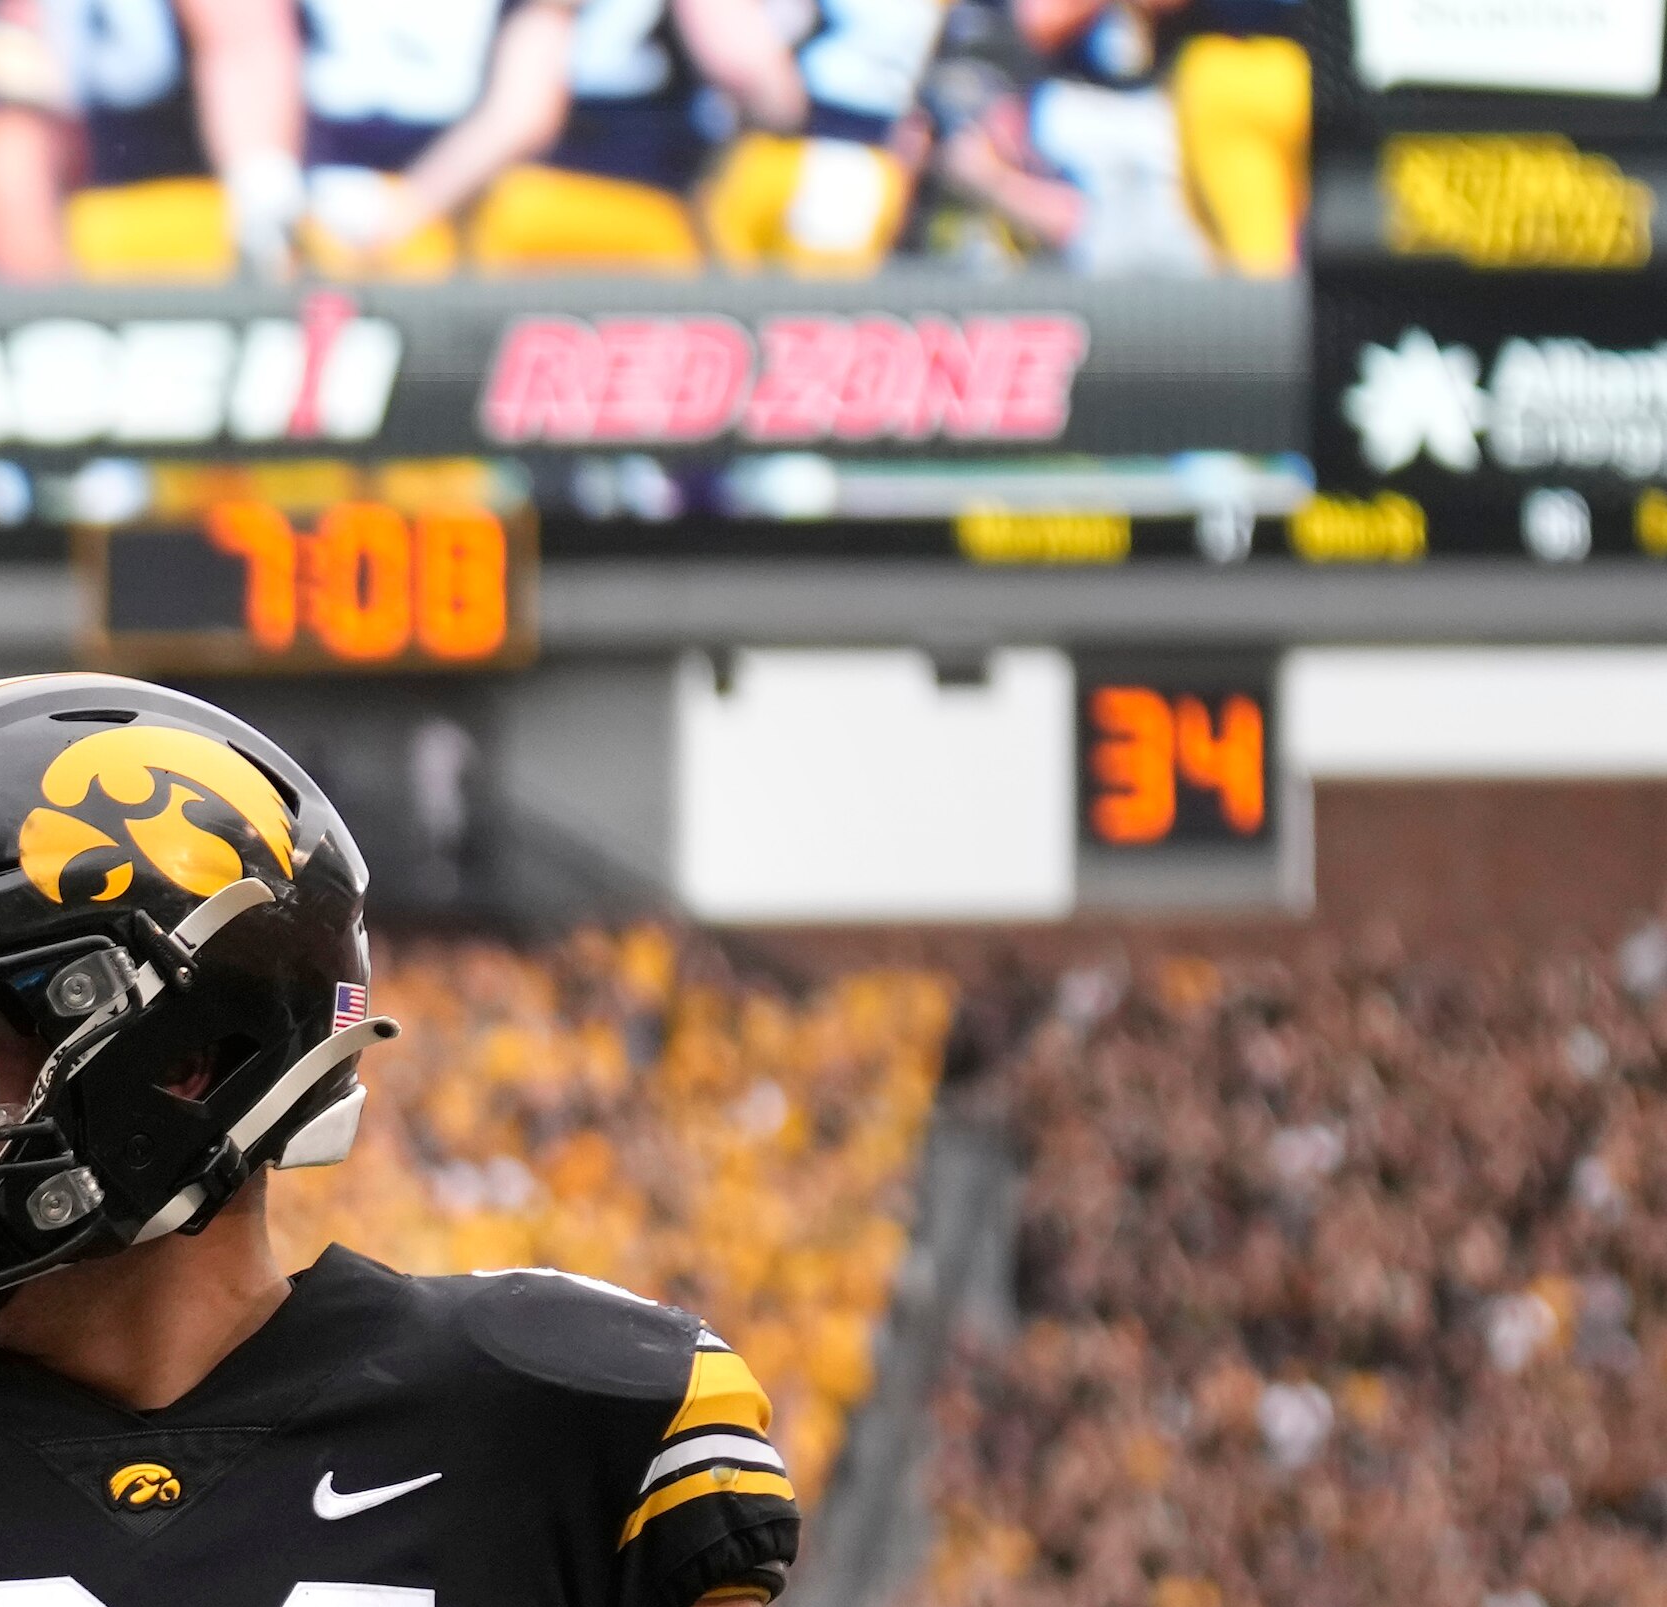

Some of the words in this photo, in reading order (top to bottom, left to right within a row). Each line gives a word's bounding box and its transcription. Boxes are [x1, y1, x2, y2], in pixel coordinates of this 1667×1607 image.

[482, 314, 754, 444] RED
[742, 314, 1088, 442] ZONE
[209, 498, 506, 661] 7:08
[1089, 685, 1266, 845] 34
